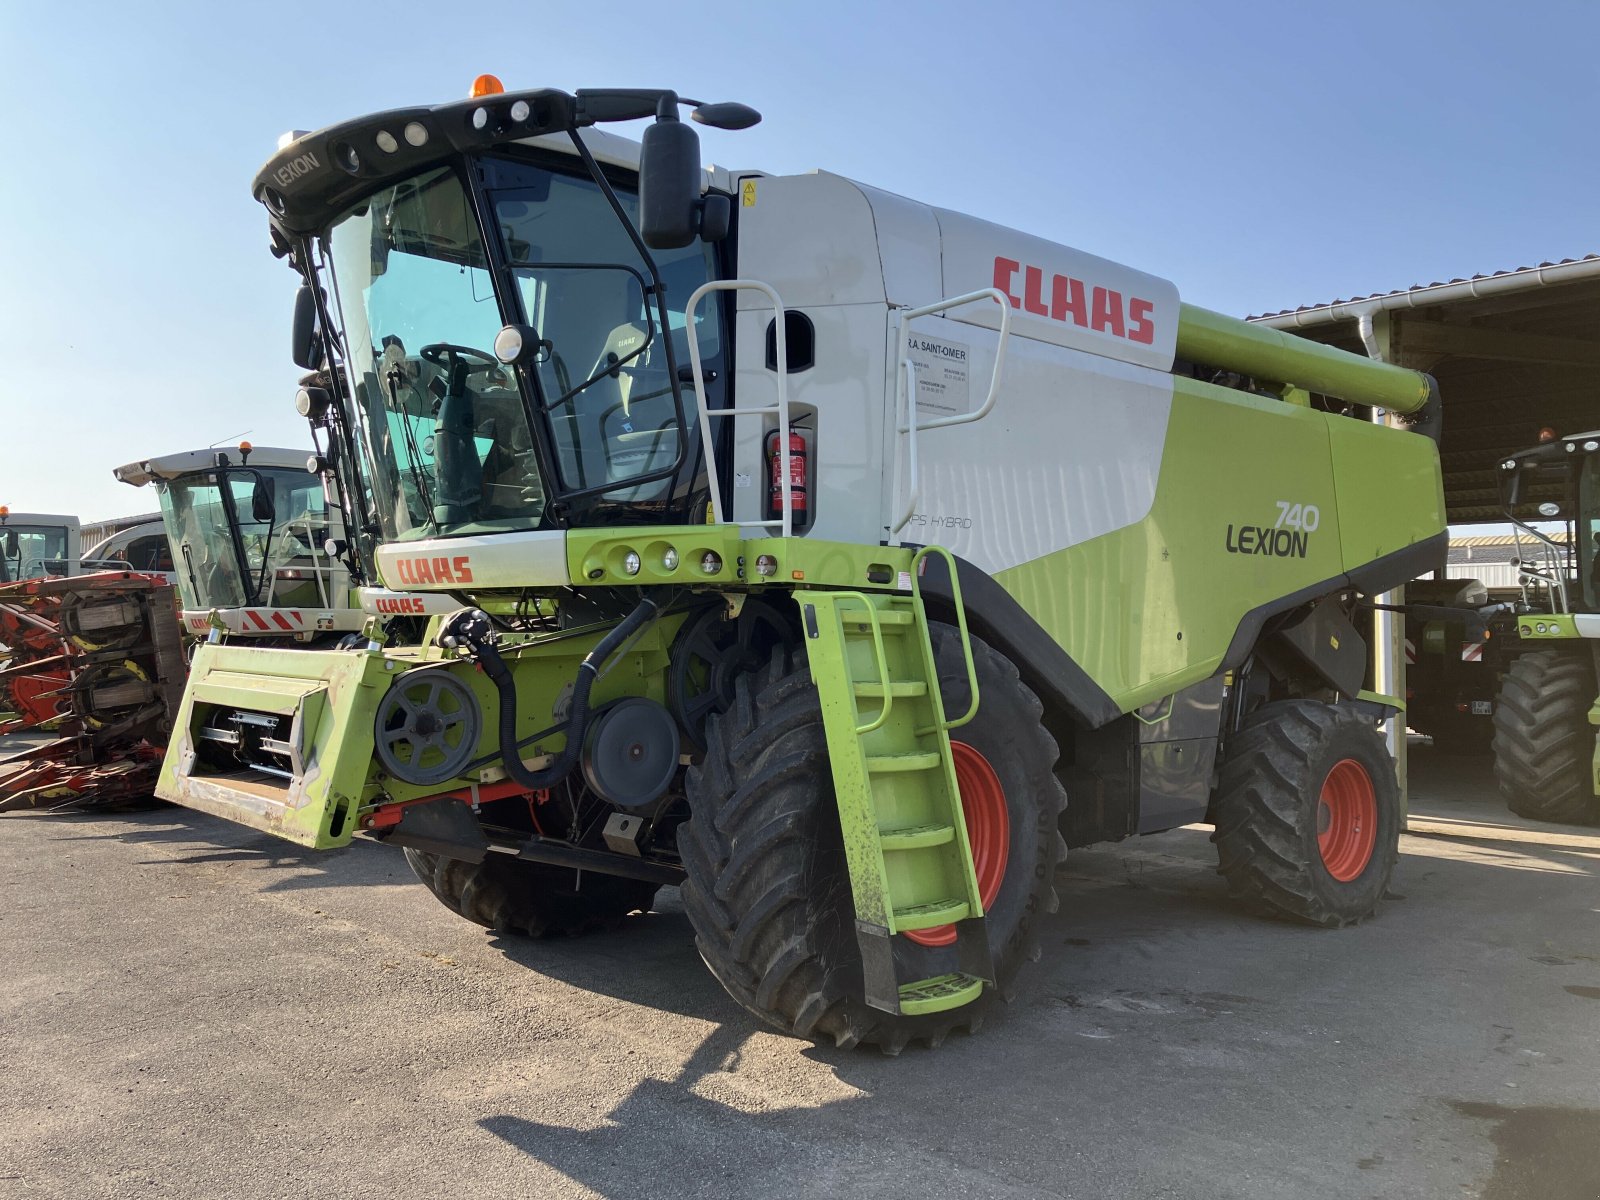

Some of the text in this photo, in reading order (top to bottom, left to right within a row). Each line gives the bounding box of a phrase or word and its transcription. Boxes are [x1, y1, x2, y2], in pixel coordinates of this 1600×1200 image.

[272, 151, 321, 187] LEXION
[992, 256, 1155, 345] CLAAS
[921, 341, 966, 360] SAINT-OMER
[908, 514, 972, 529] PS HYBRID
[1274, 500, 1320, 532] 740
[1225, 524, 1309, 558] LEXION
[396, 556, 473, 585] CLAAS
[375, 598, 425, 614] CLAAS
